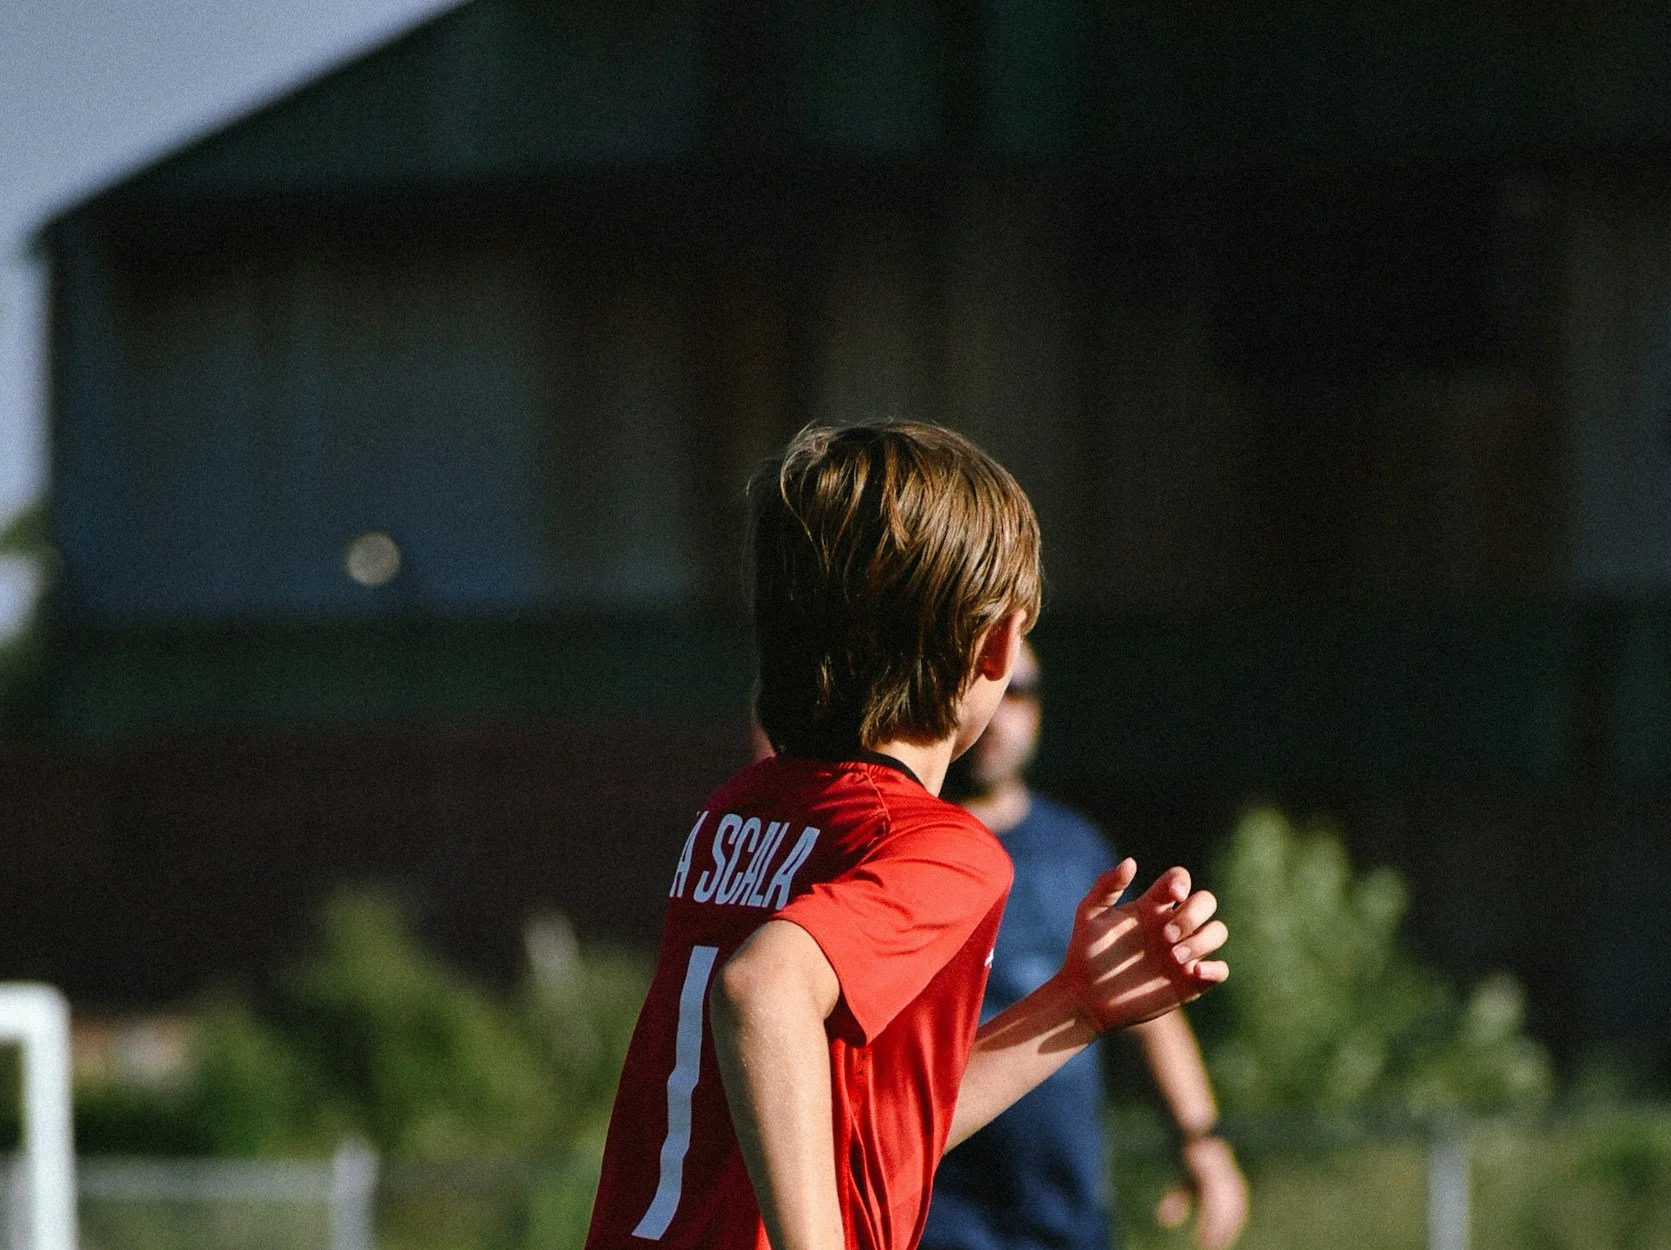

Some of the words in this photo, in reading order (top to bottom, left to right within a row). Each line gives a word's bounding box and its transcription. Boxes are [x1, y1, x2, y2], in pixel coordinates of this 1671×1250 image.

[669, 810, 709, 899] A
[693, 813, 821, 911] SCALA
[631, 945, 719, 1241] 1
